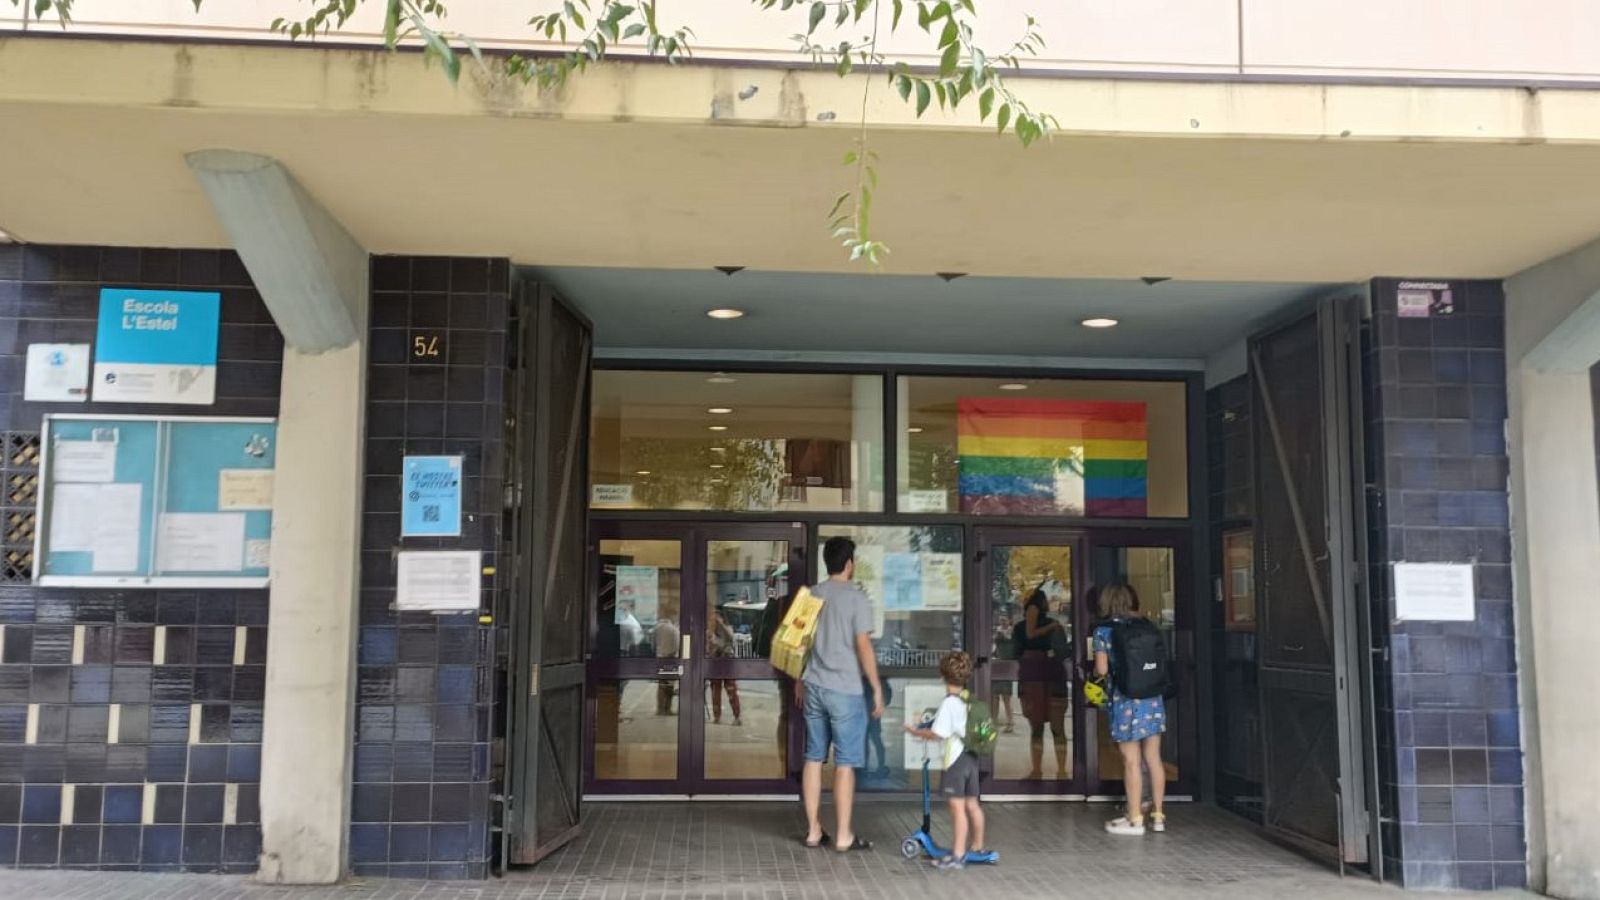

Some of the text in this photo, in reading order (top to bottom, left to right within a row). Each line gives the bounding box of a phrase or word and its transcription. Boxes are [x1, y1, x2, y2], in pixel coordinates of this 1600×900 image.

[123, 299, 179, 314] Escola
[121, 315, 177, 330] L'Estel
[414, 336, 439, 356] 54
